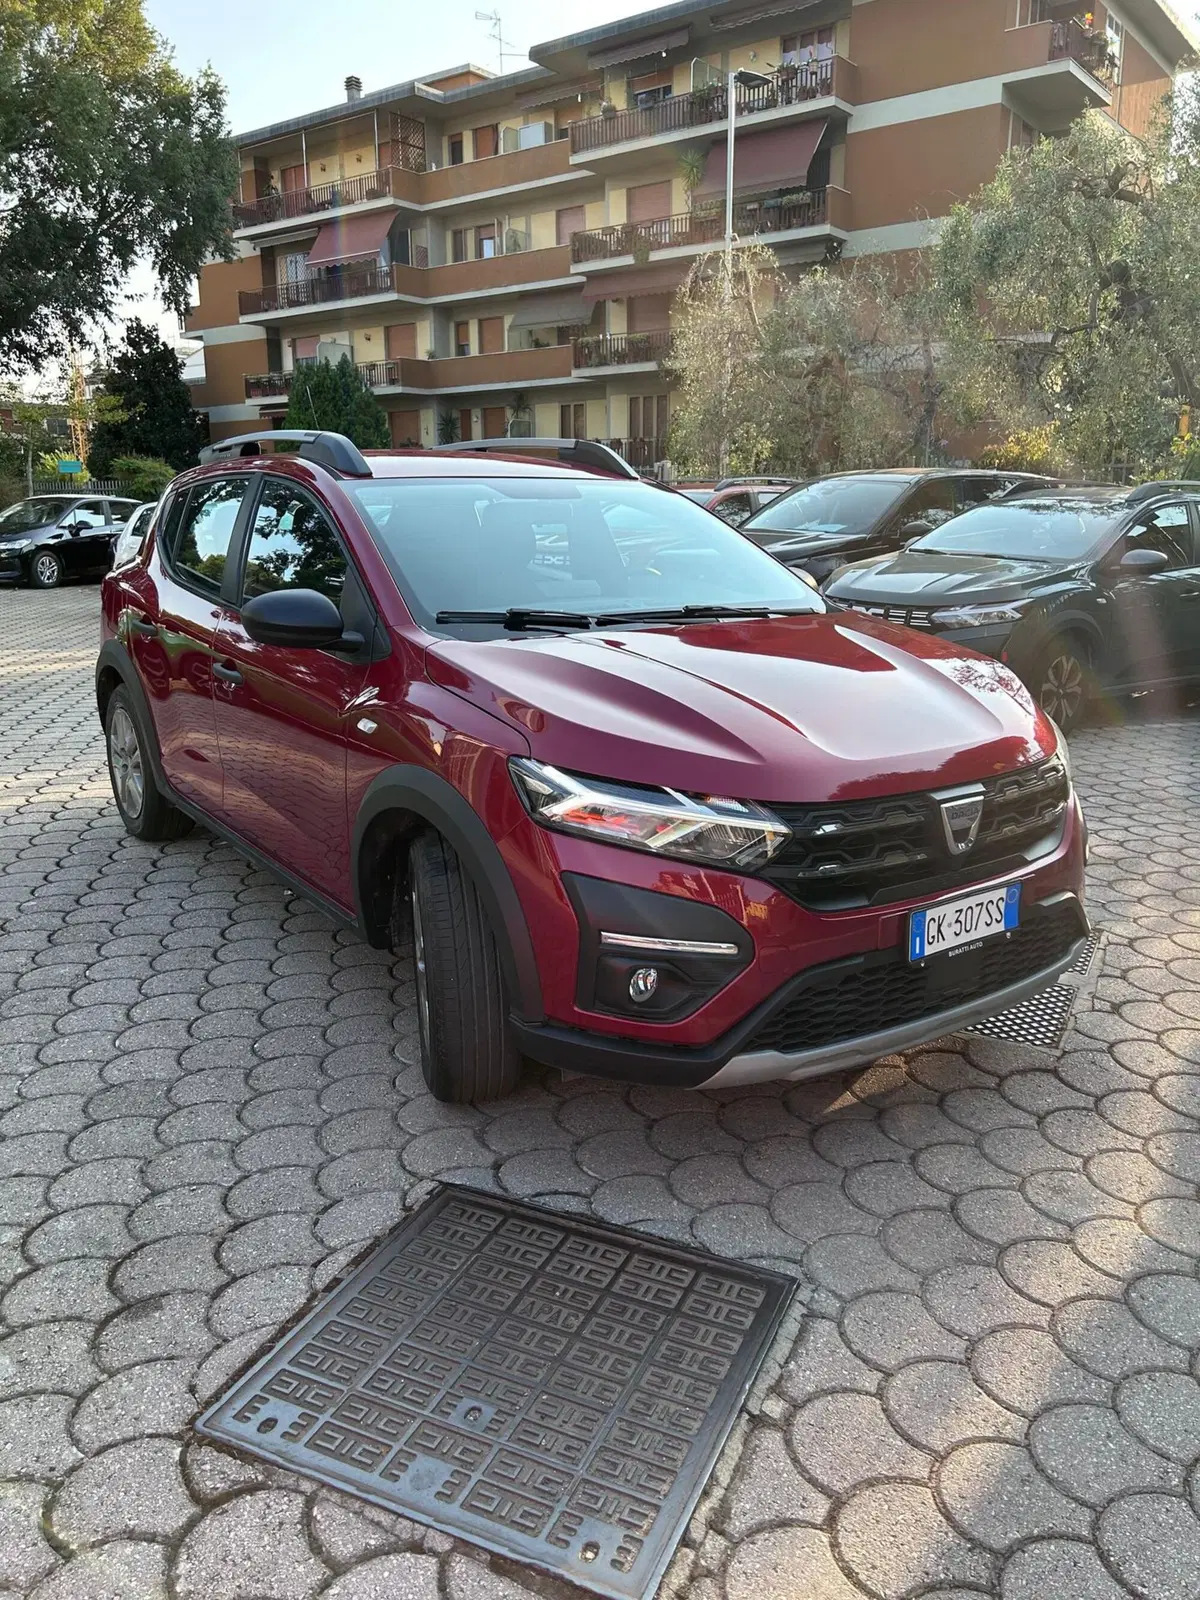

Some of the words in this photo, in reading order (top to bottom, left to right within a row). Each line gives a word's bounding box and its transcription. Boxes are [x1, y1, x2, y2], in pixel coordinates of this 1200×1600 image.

[951, 807, 980, 820] DACIA
[948, 945, 970, 957] BURATTI
[969, 941, 984, 950] AUTO
